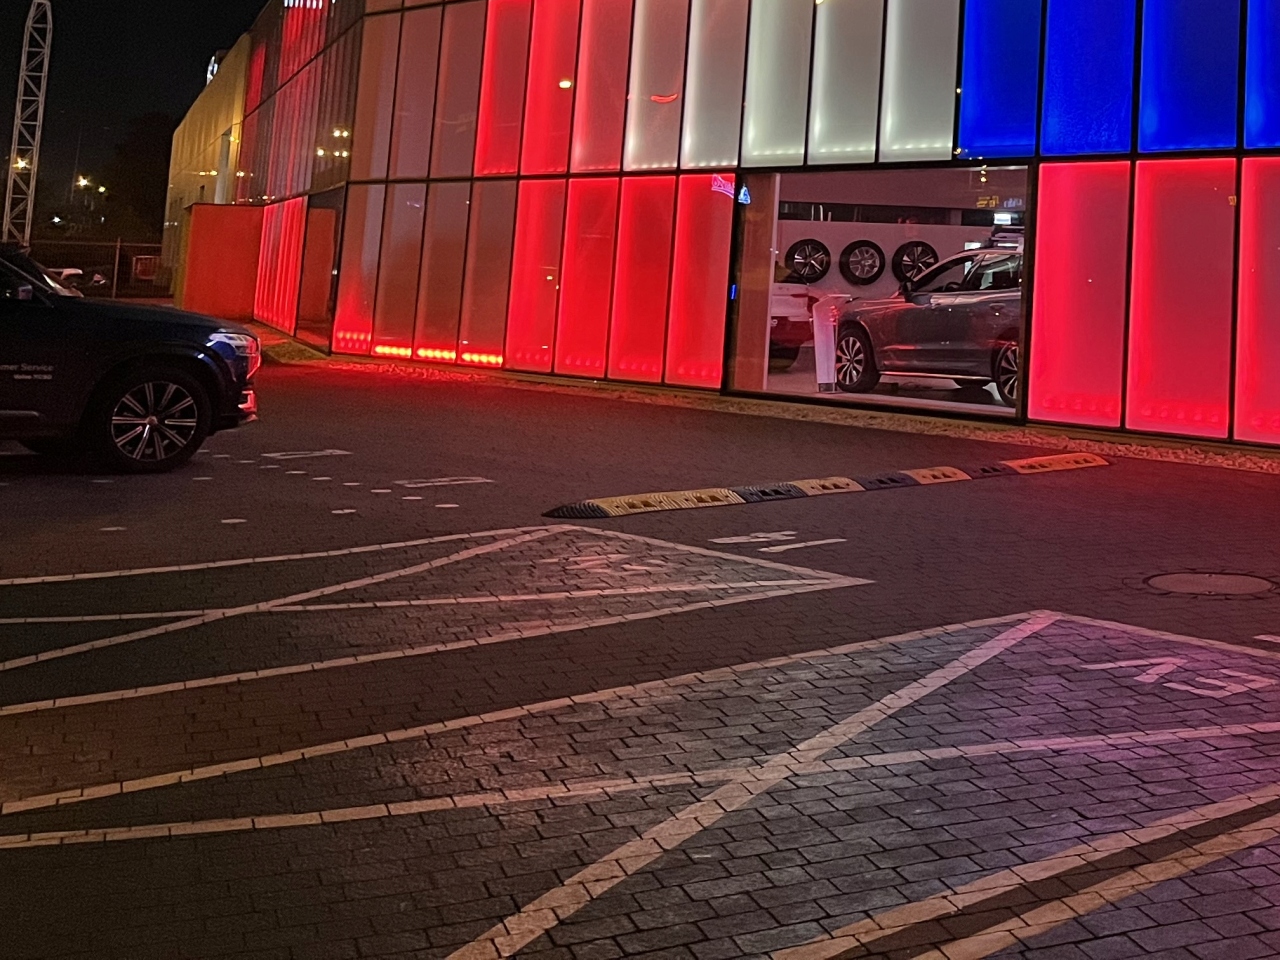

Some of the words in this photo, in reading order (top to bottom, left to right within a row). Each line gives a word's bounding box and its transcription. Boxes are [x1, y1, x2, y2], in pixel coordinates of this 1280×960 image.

[21, 363, 54, 371] Service
[708, 530, 848, 553] 14
[1079, 656, 1280, 698] EV
